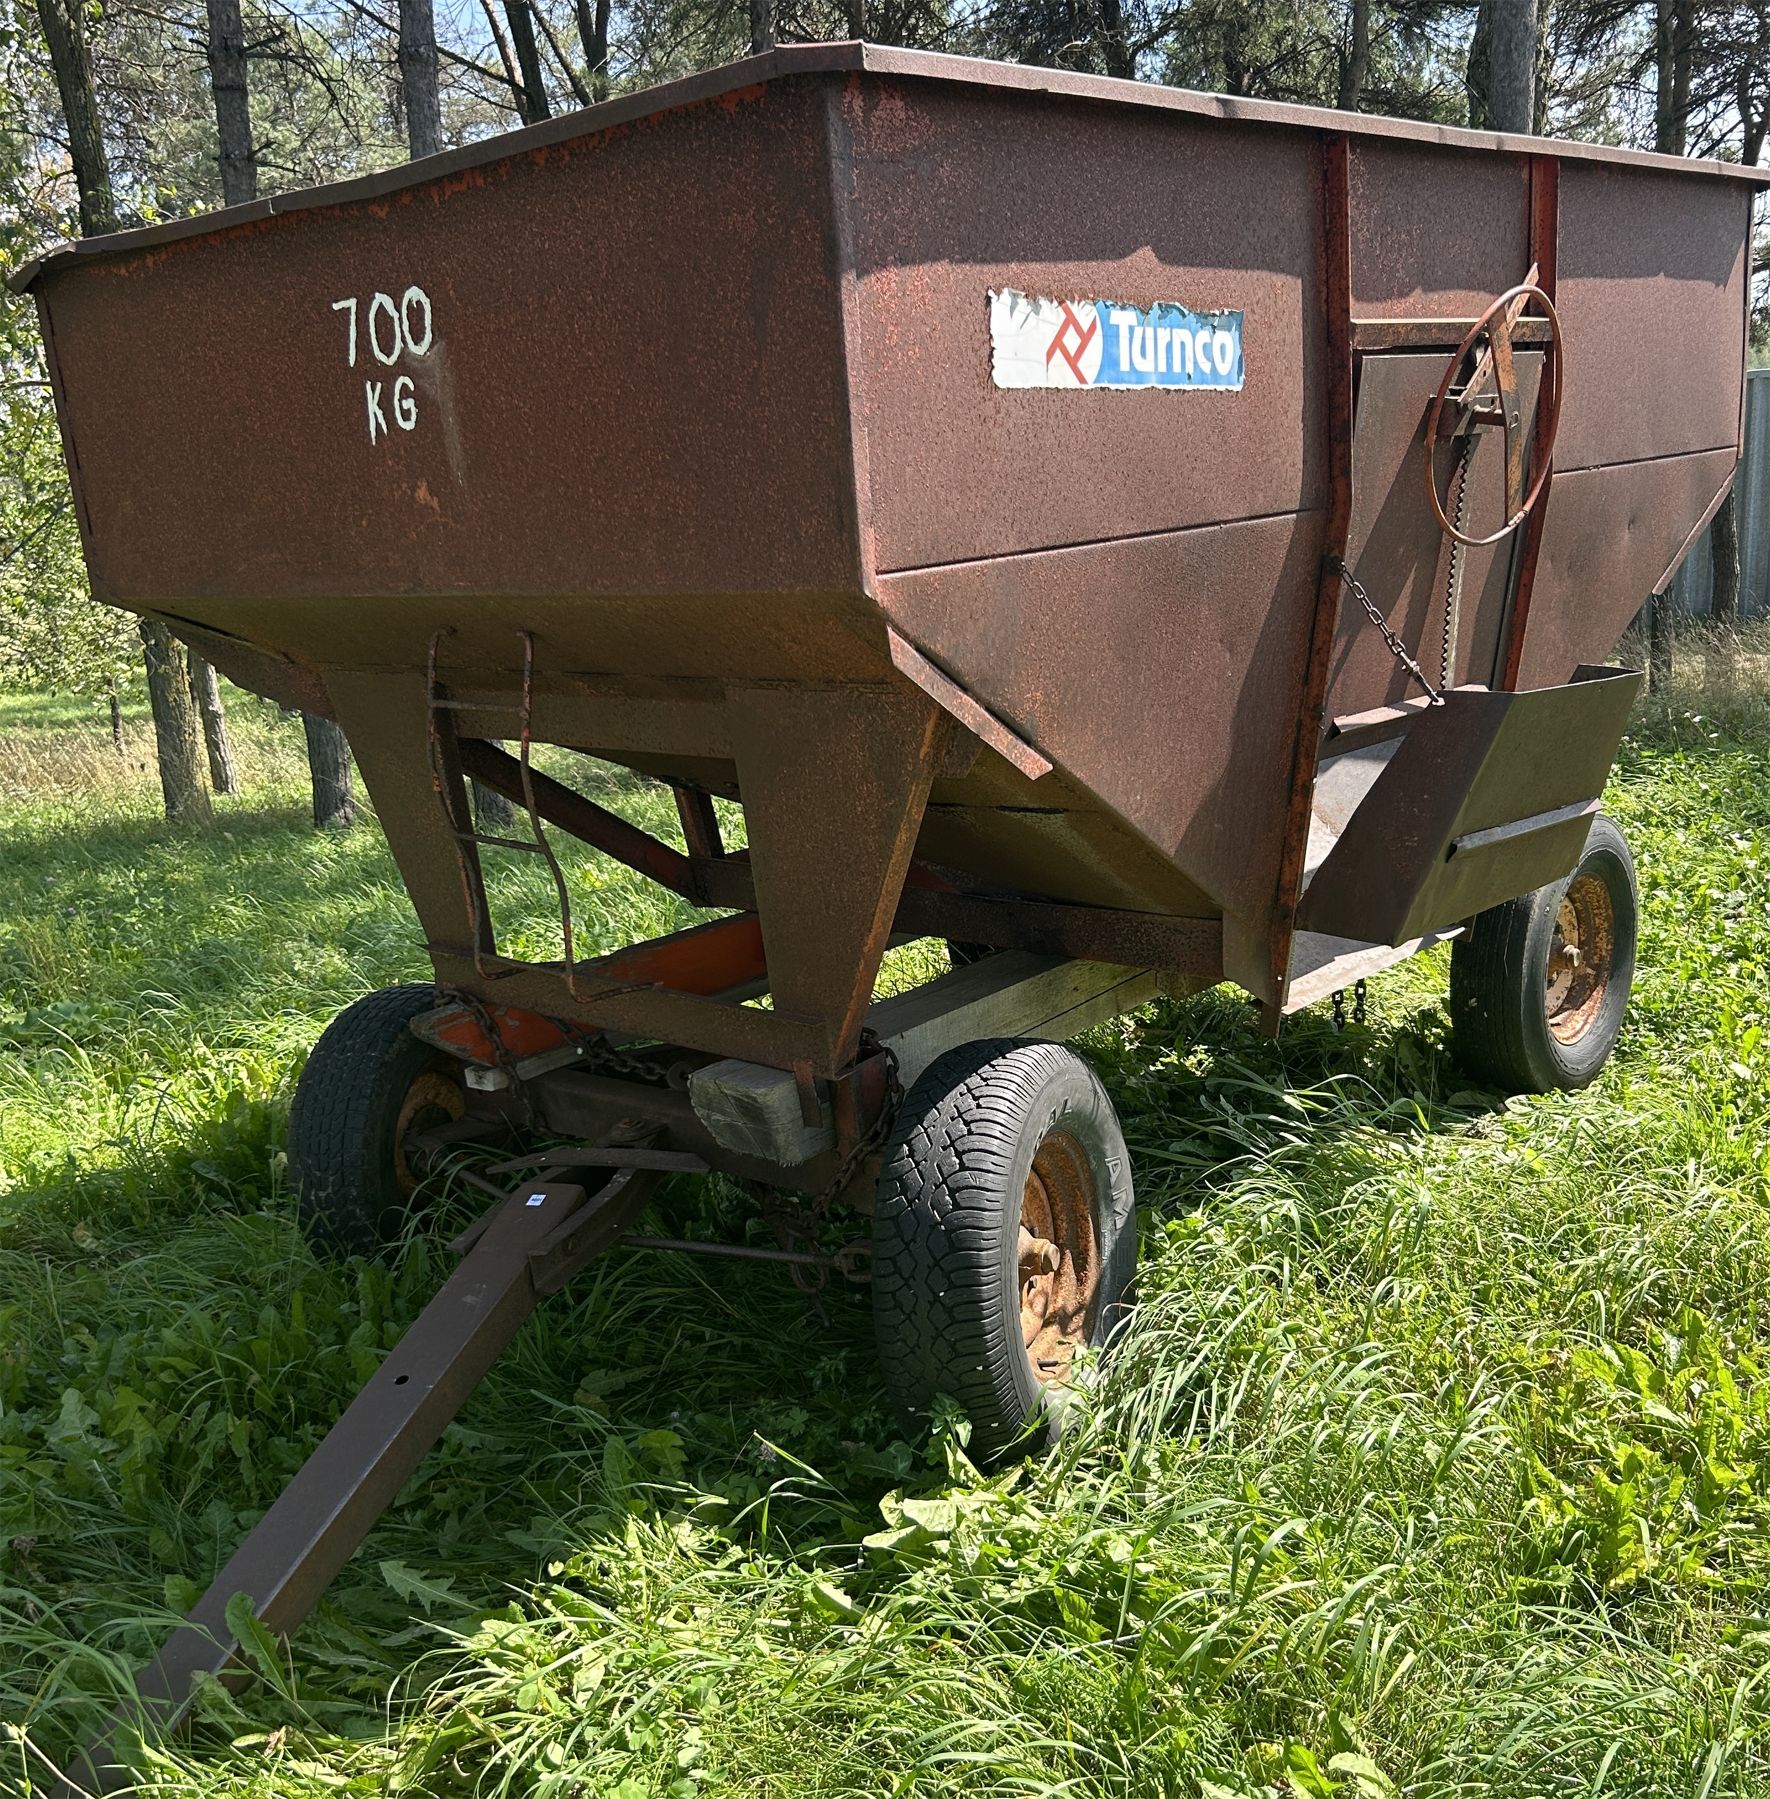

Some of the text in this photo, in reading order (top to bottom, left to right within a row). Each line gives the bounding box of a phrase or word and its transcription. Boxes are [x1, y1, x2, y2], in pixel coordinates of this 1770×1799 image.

[332, 285, 433, 368] 700
[1109, 309, 1234, 376] Turnco
[365, 375, 419, 446] KG
